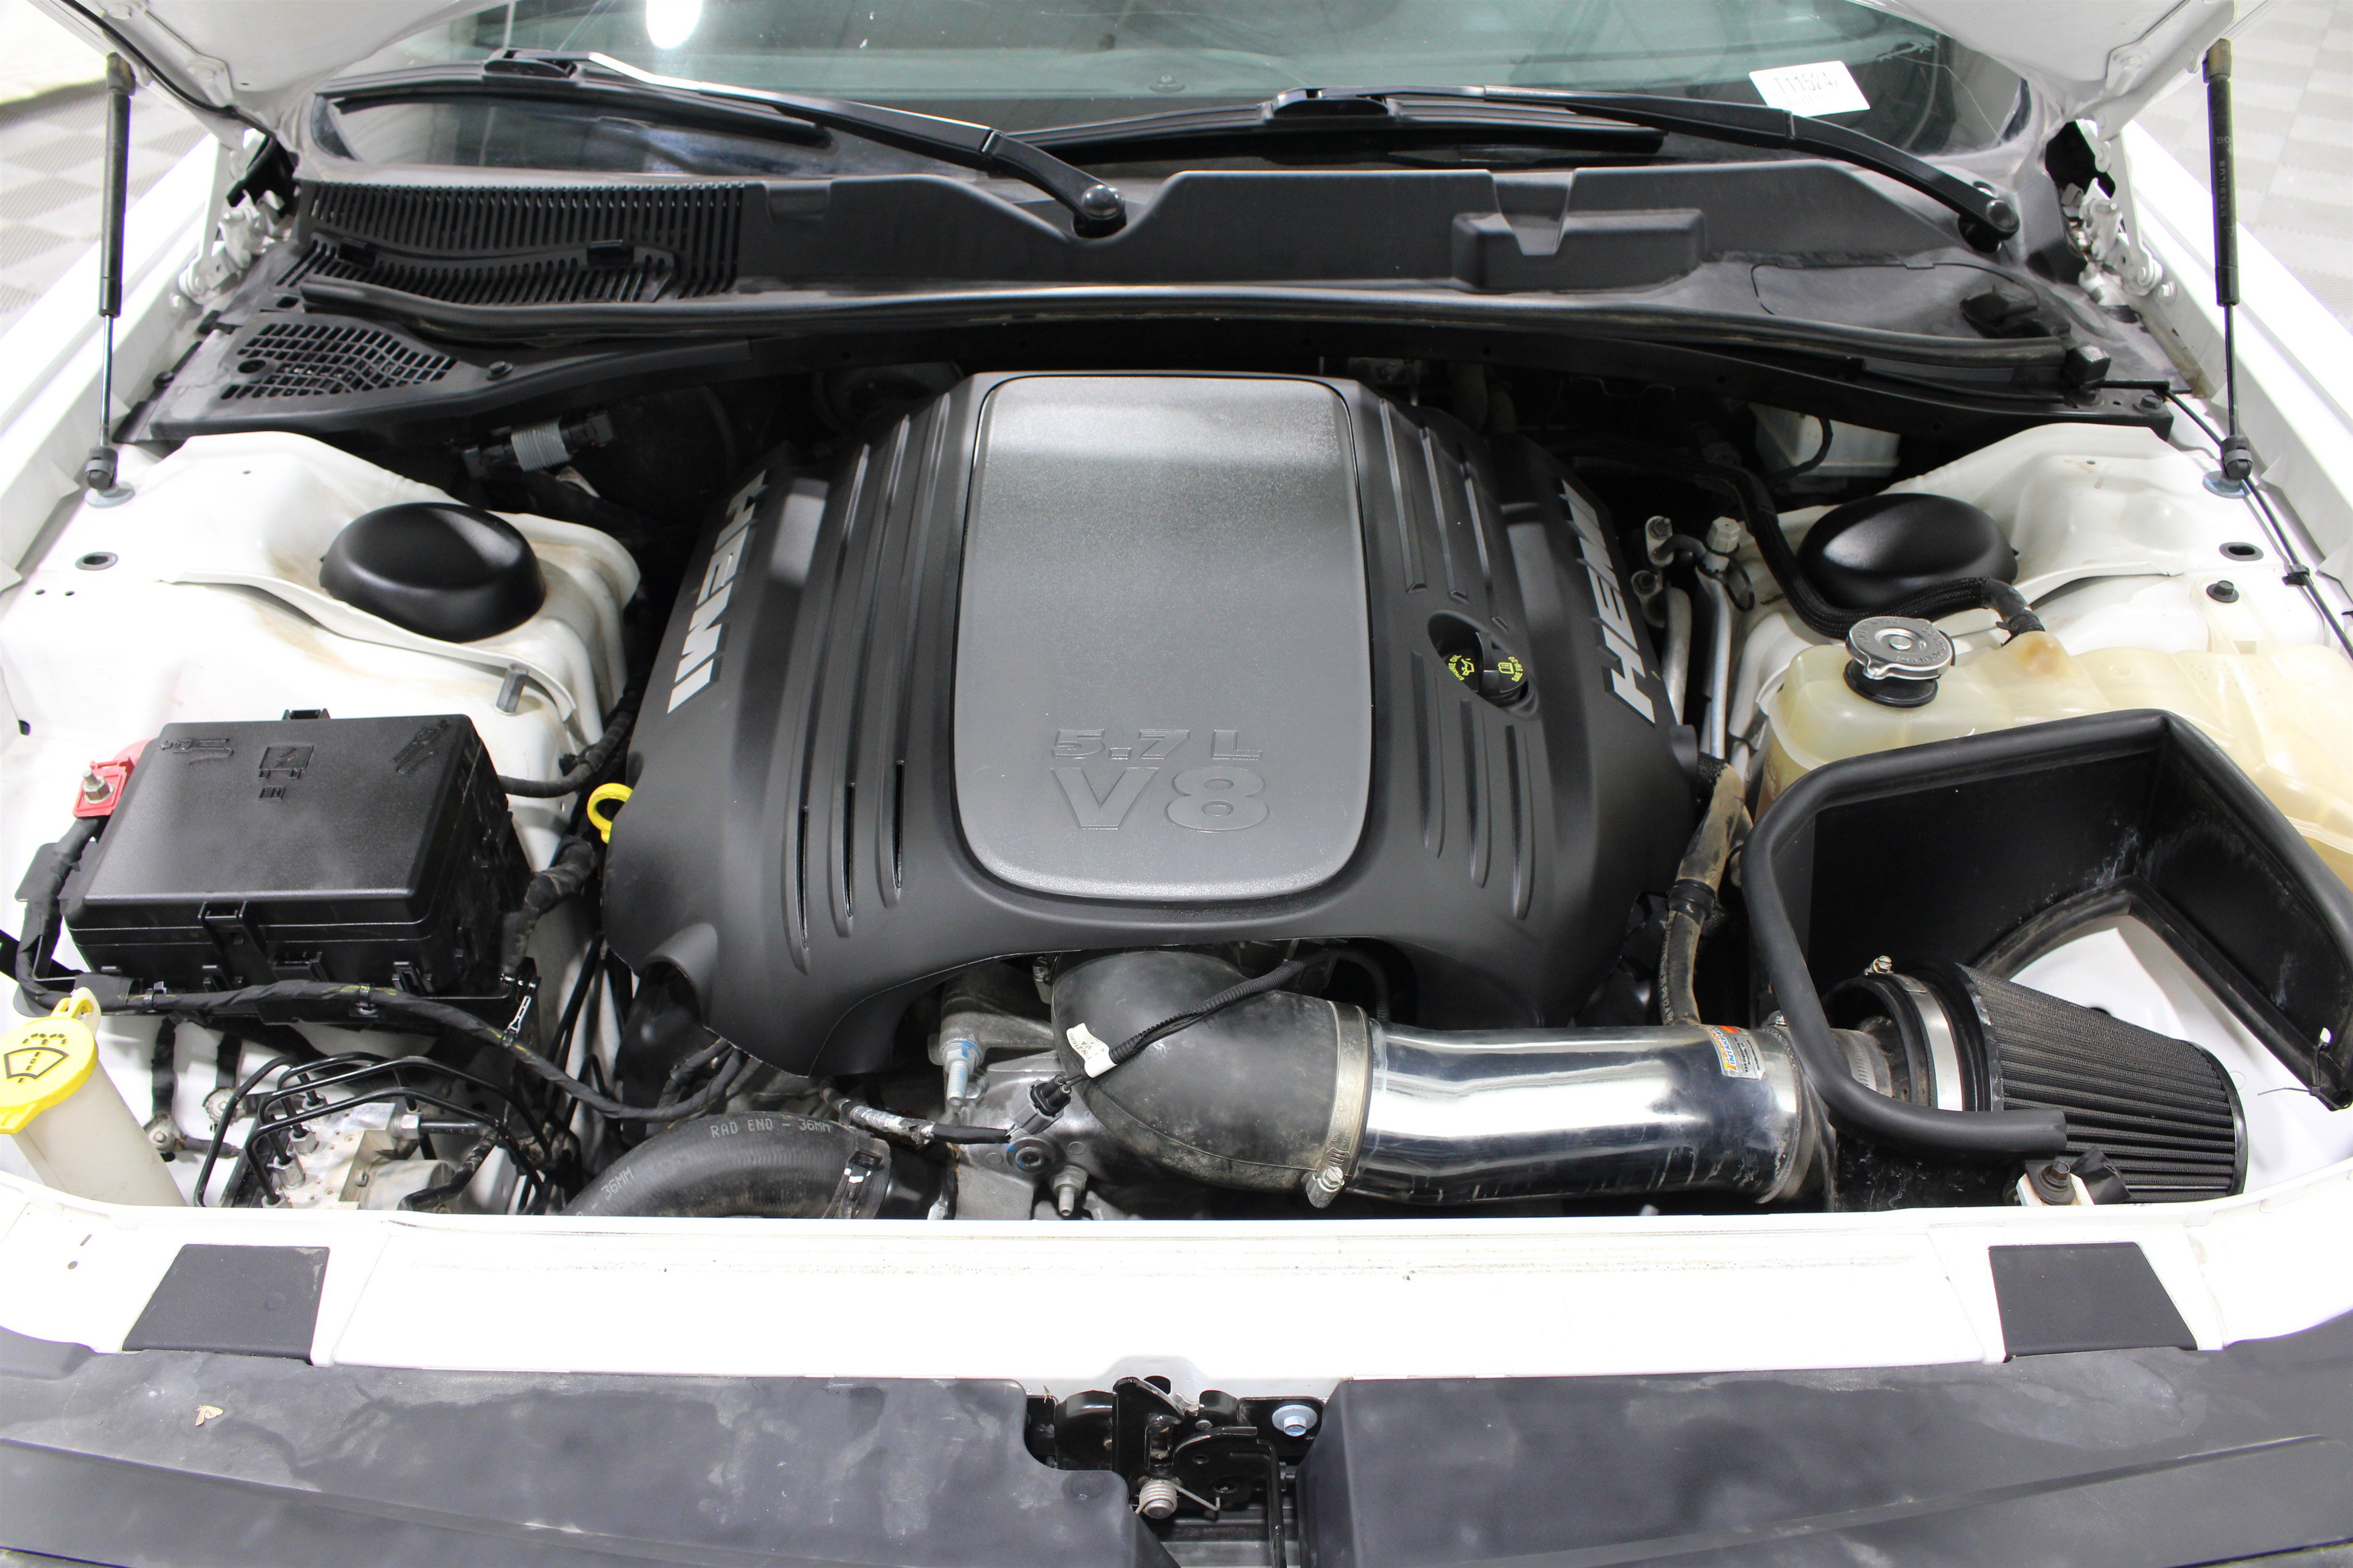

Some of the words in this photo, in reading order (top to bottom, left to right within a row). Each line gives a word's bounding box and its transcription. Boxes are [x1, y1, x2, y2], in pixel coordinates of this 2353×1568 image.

[2219, 160, 2227, 217] STABILUS
[667, 469, 768, 714] HEMI
[1561, 478, 1656, 723] HEMI
[1511, 671, 1523, 682] SAE
[1050, 766, 1270, 832] V8
[1721, 1037, 1736, 1065] INTAKE
[710, 1122, 738, 1138] RAD
[748, 1118, 773, 1131] END
[798, 1119, 831, 1133] 36MM
[601, 1167, 634, 1200] 36MM
